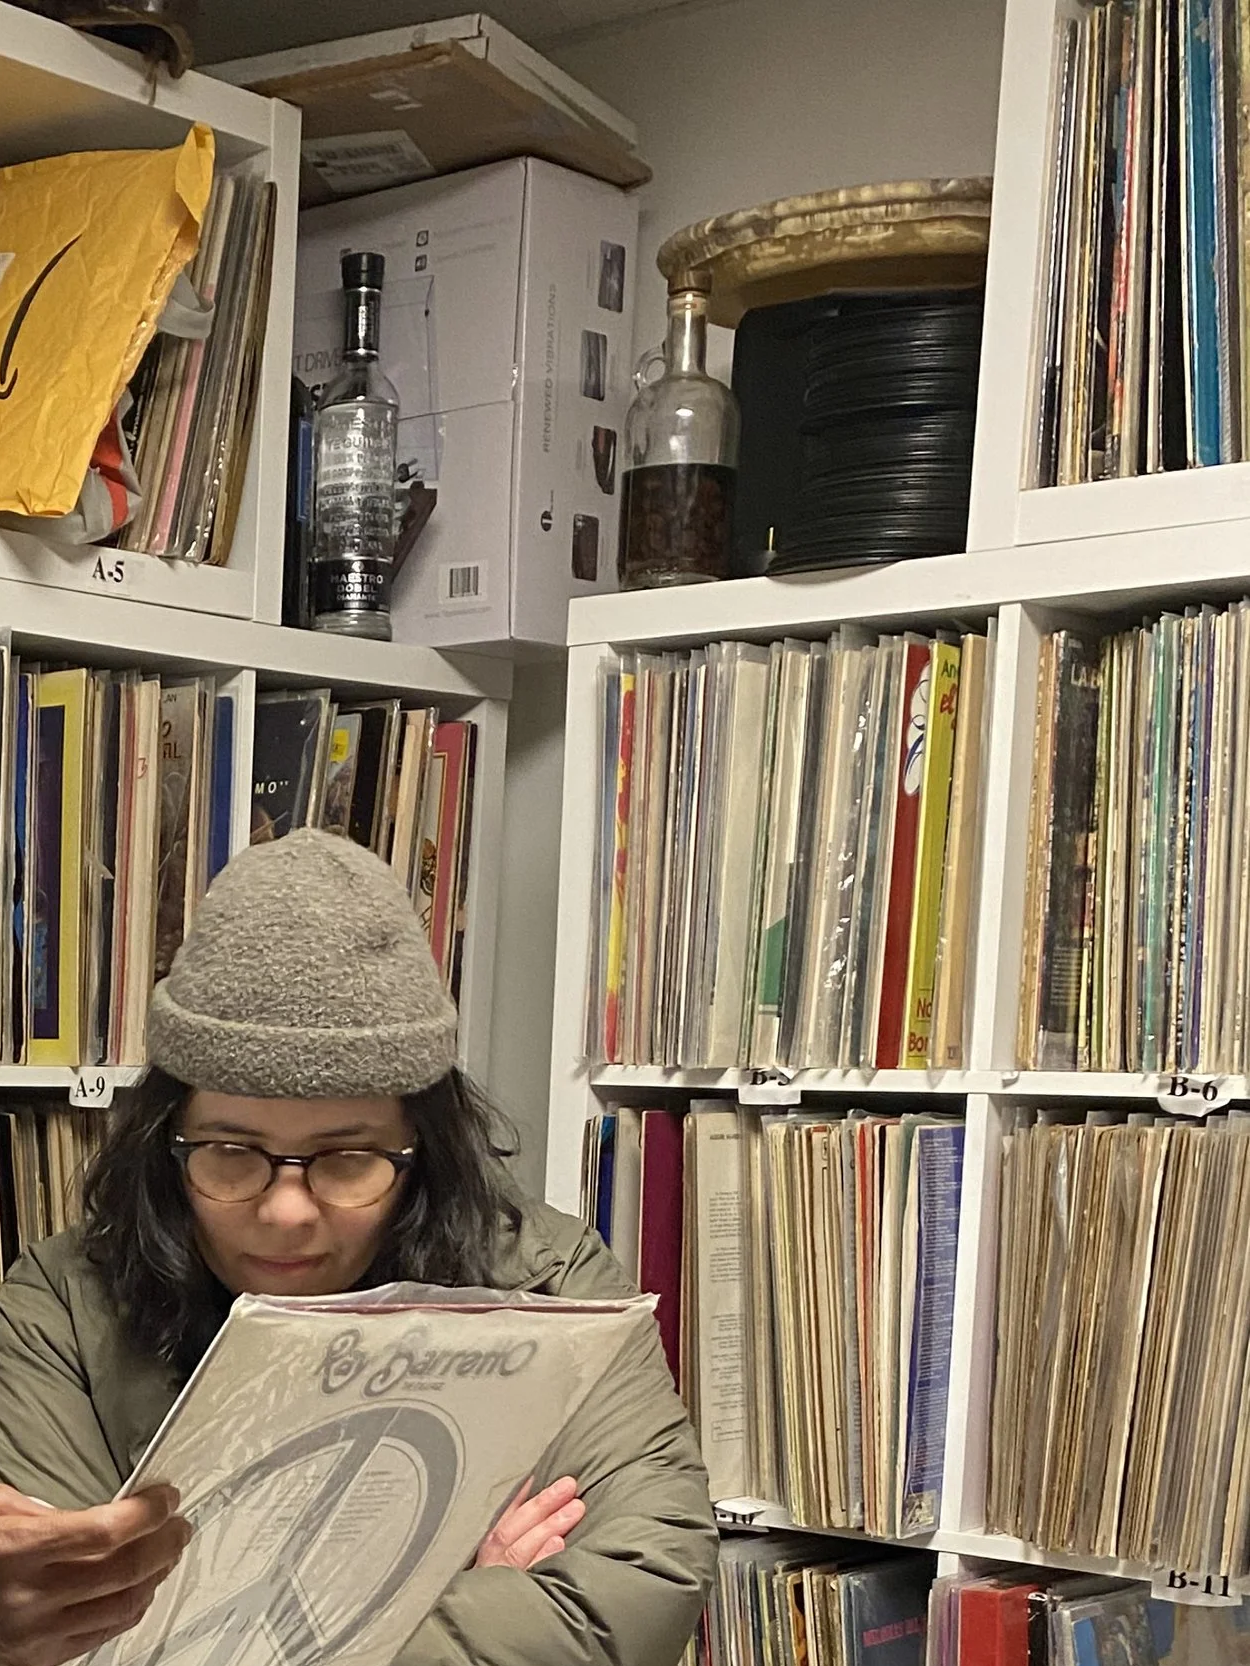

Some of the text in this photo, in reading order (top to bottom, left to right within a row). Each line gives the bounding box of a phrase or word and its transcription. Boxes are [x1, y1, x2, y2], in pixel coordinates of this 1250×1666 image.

[92, 557, 126, 585] A-5
[331, 573, 384, 585] MAESTRO
[337, 583, 378, 594] DOBEL
[74, 1074, 106, 1098] A-9
[1166, 1076, 1220, 1103] B-6
[1166, 1569, 1233, 1598] B-11
